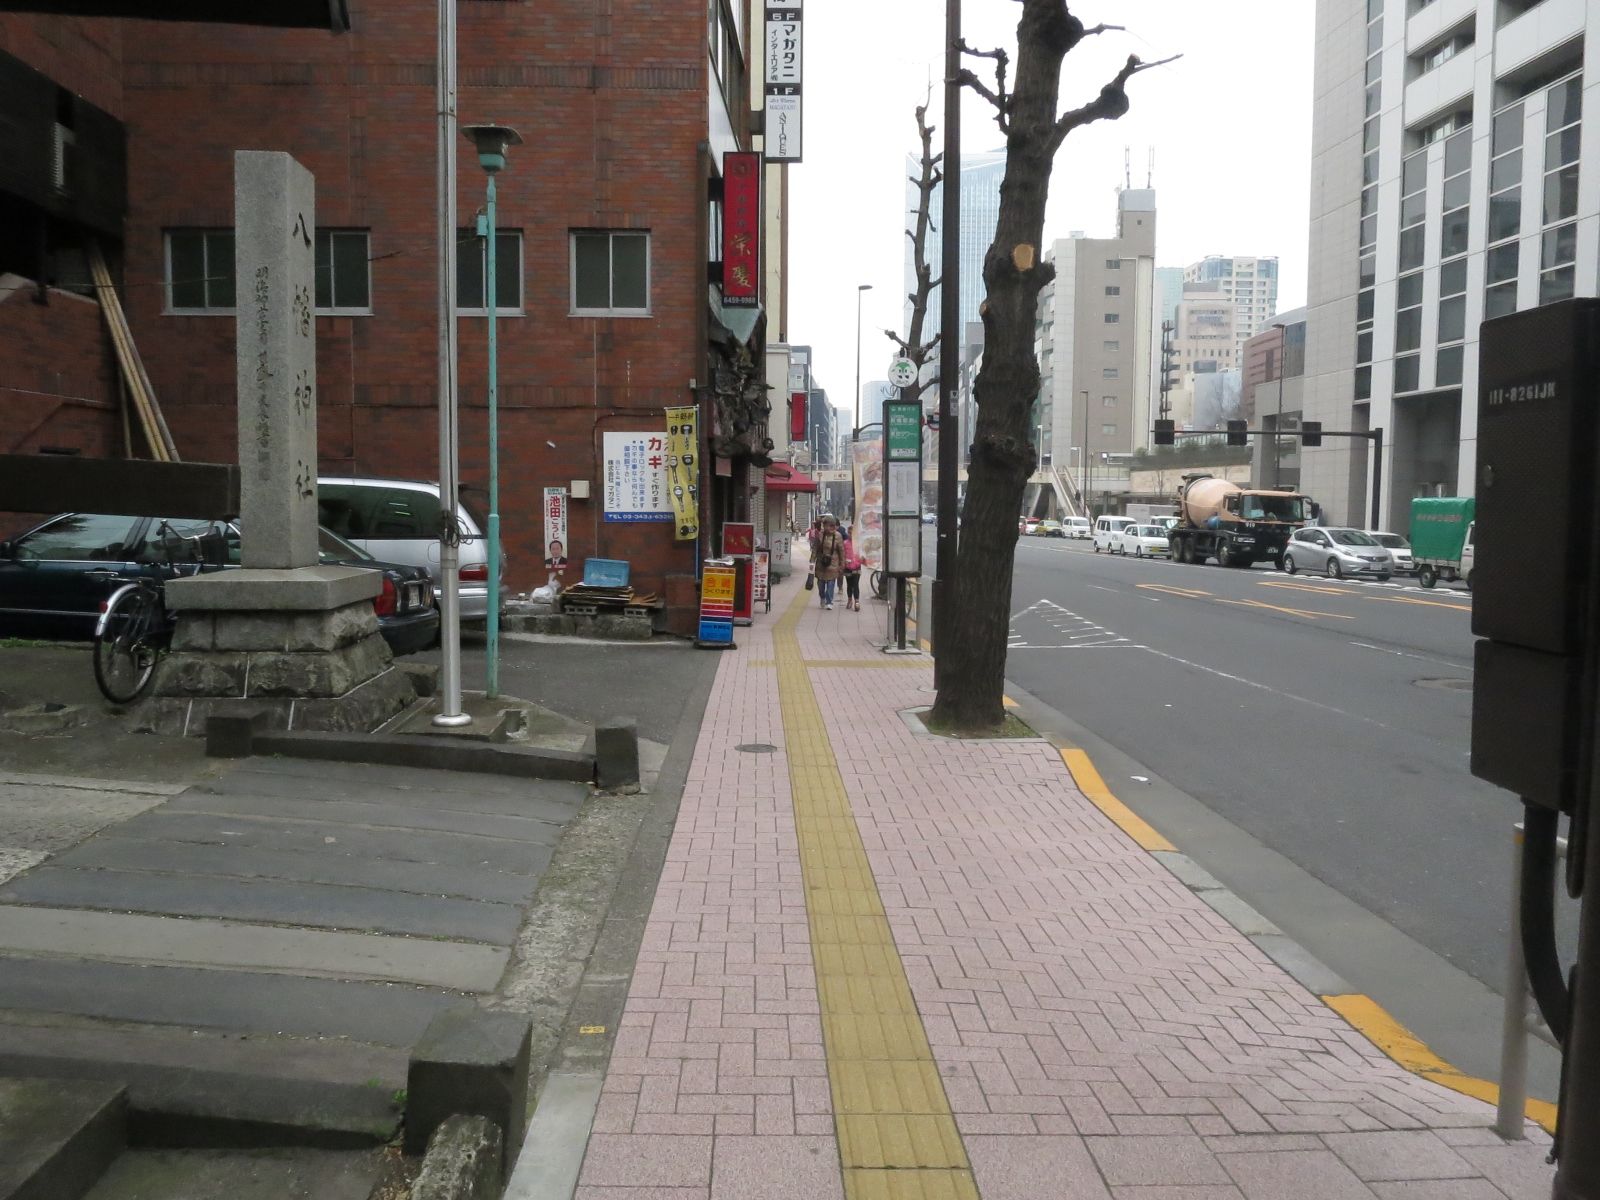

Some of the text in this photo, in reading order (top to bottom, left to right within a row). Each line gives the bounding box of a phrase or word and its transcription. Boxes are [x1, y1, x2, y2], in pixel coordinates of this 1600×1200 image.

[783, 24, 797, 77] マガタニ
[773, 87, 794, 95] 1F
[648, 437, 662, 469] カギ
[651, 472, 660, 508] すぐ作ります
[550, 496, 561, 540] 池田こうじ
